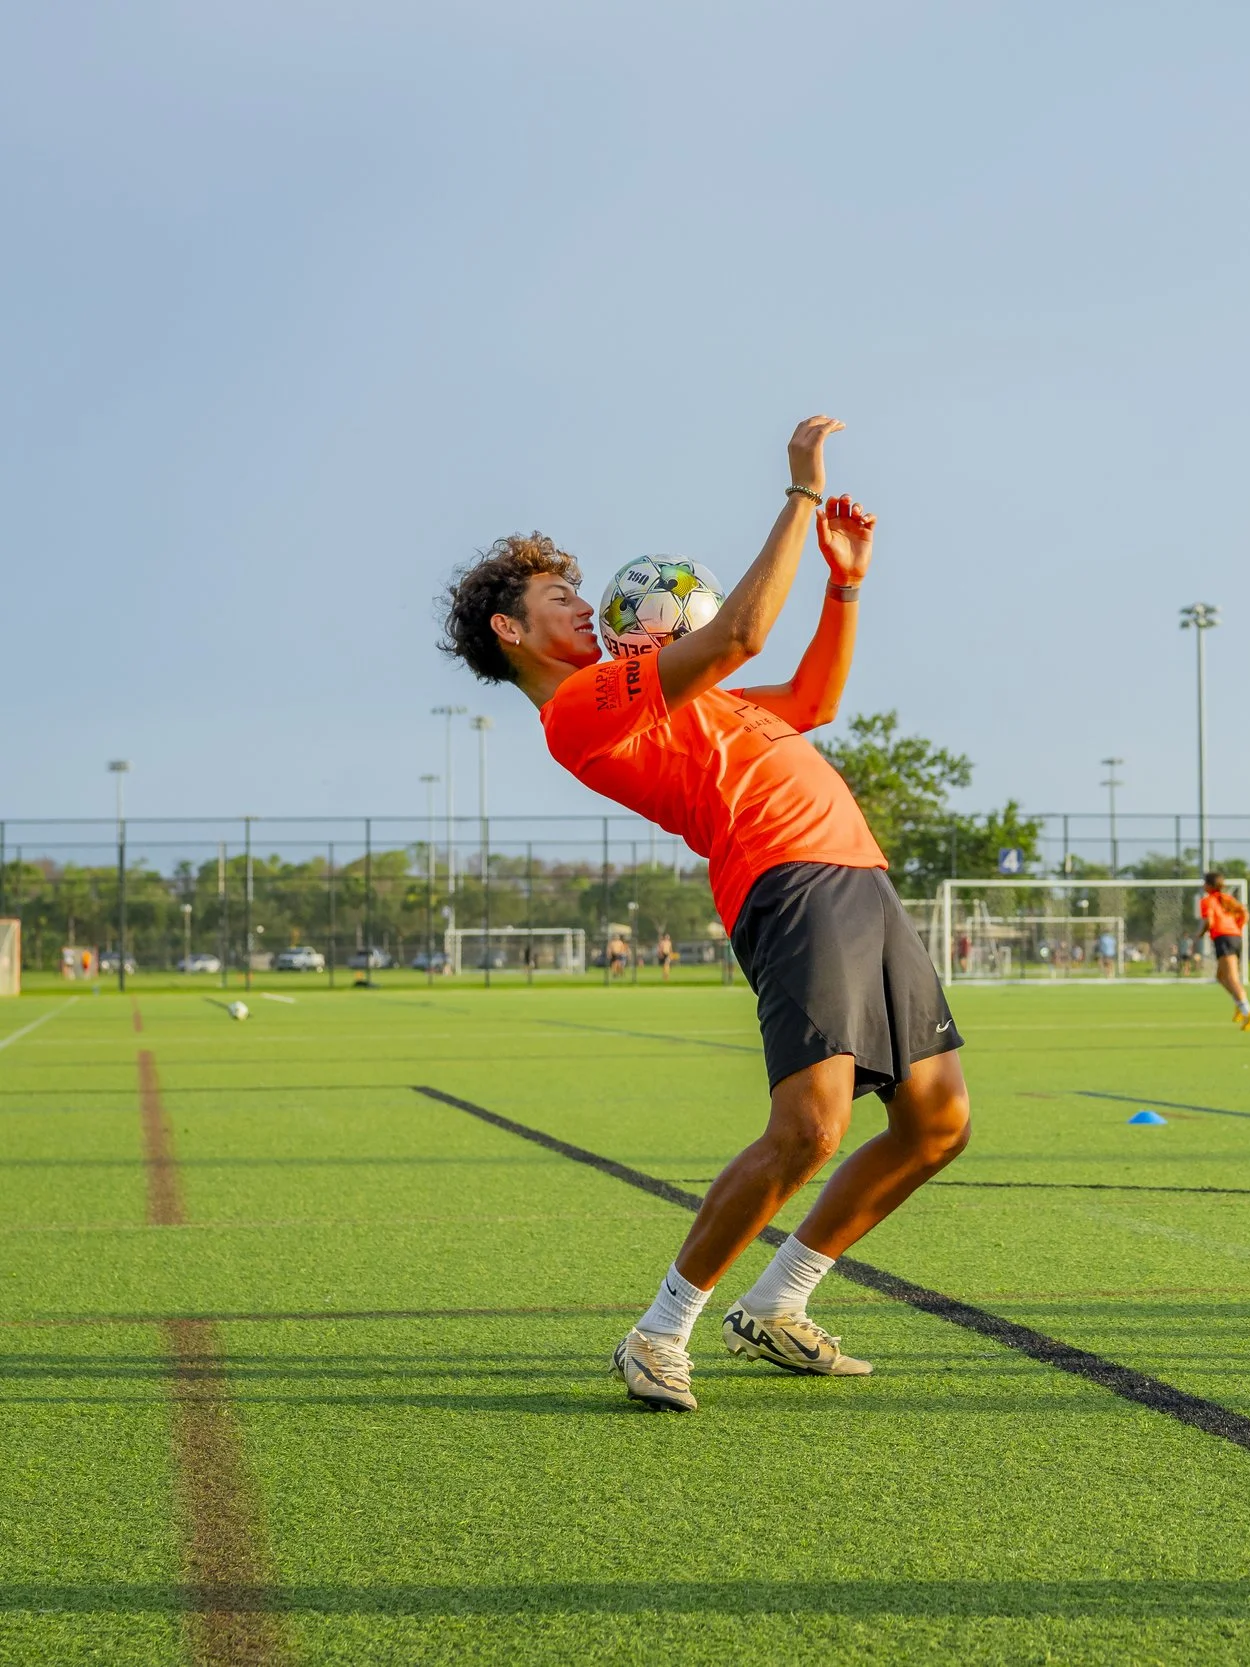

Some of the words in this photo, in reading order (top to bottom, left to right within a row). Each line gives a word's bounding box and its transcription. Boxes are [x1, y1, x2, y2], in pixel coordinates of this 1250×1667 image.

[627, 570, 650, 586] USL
[596, 666, 610, 711] MAPA
[1002, 848, 1018, 873] 4
